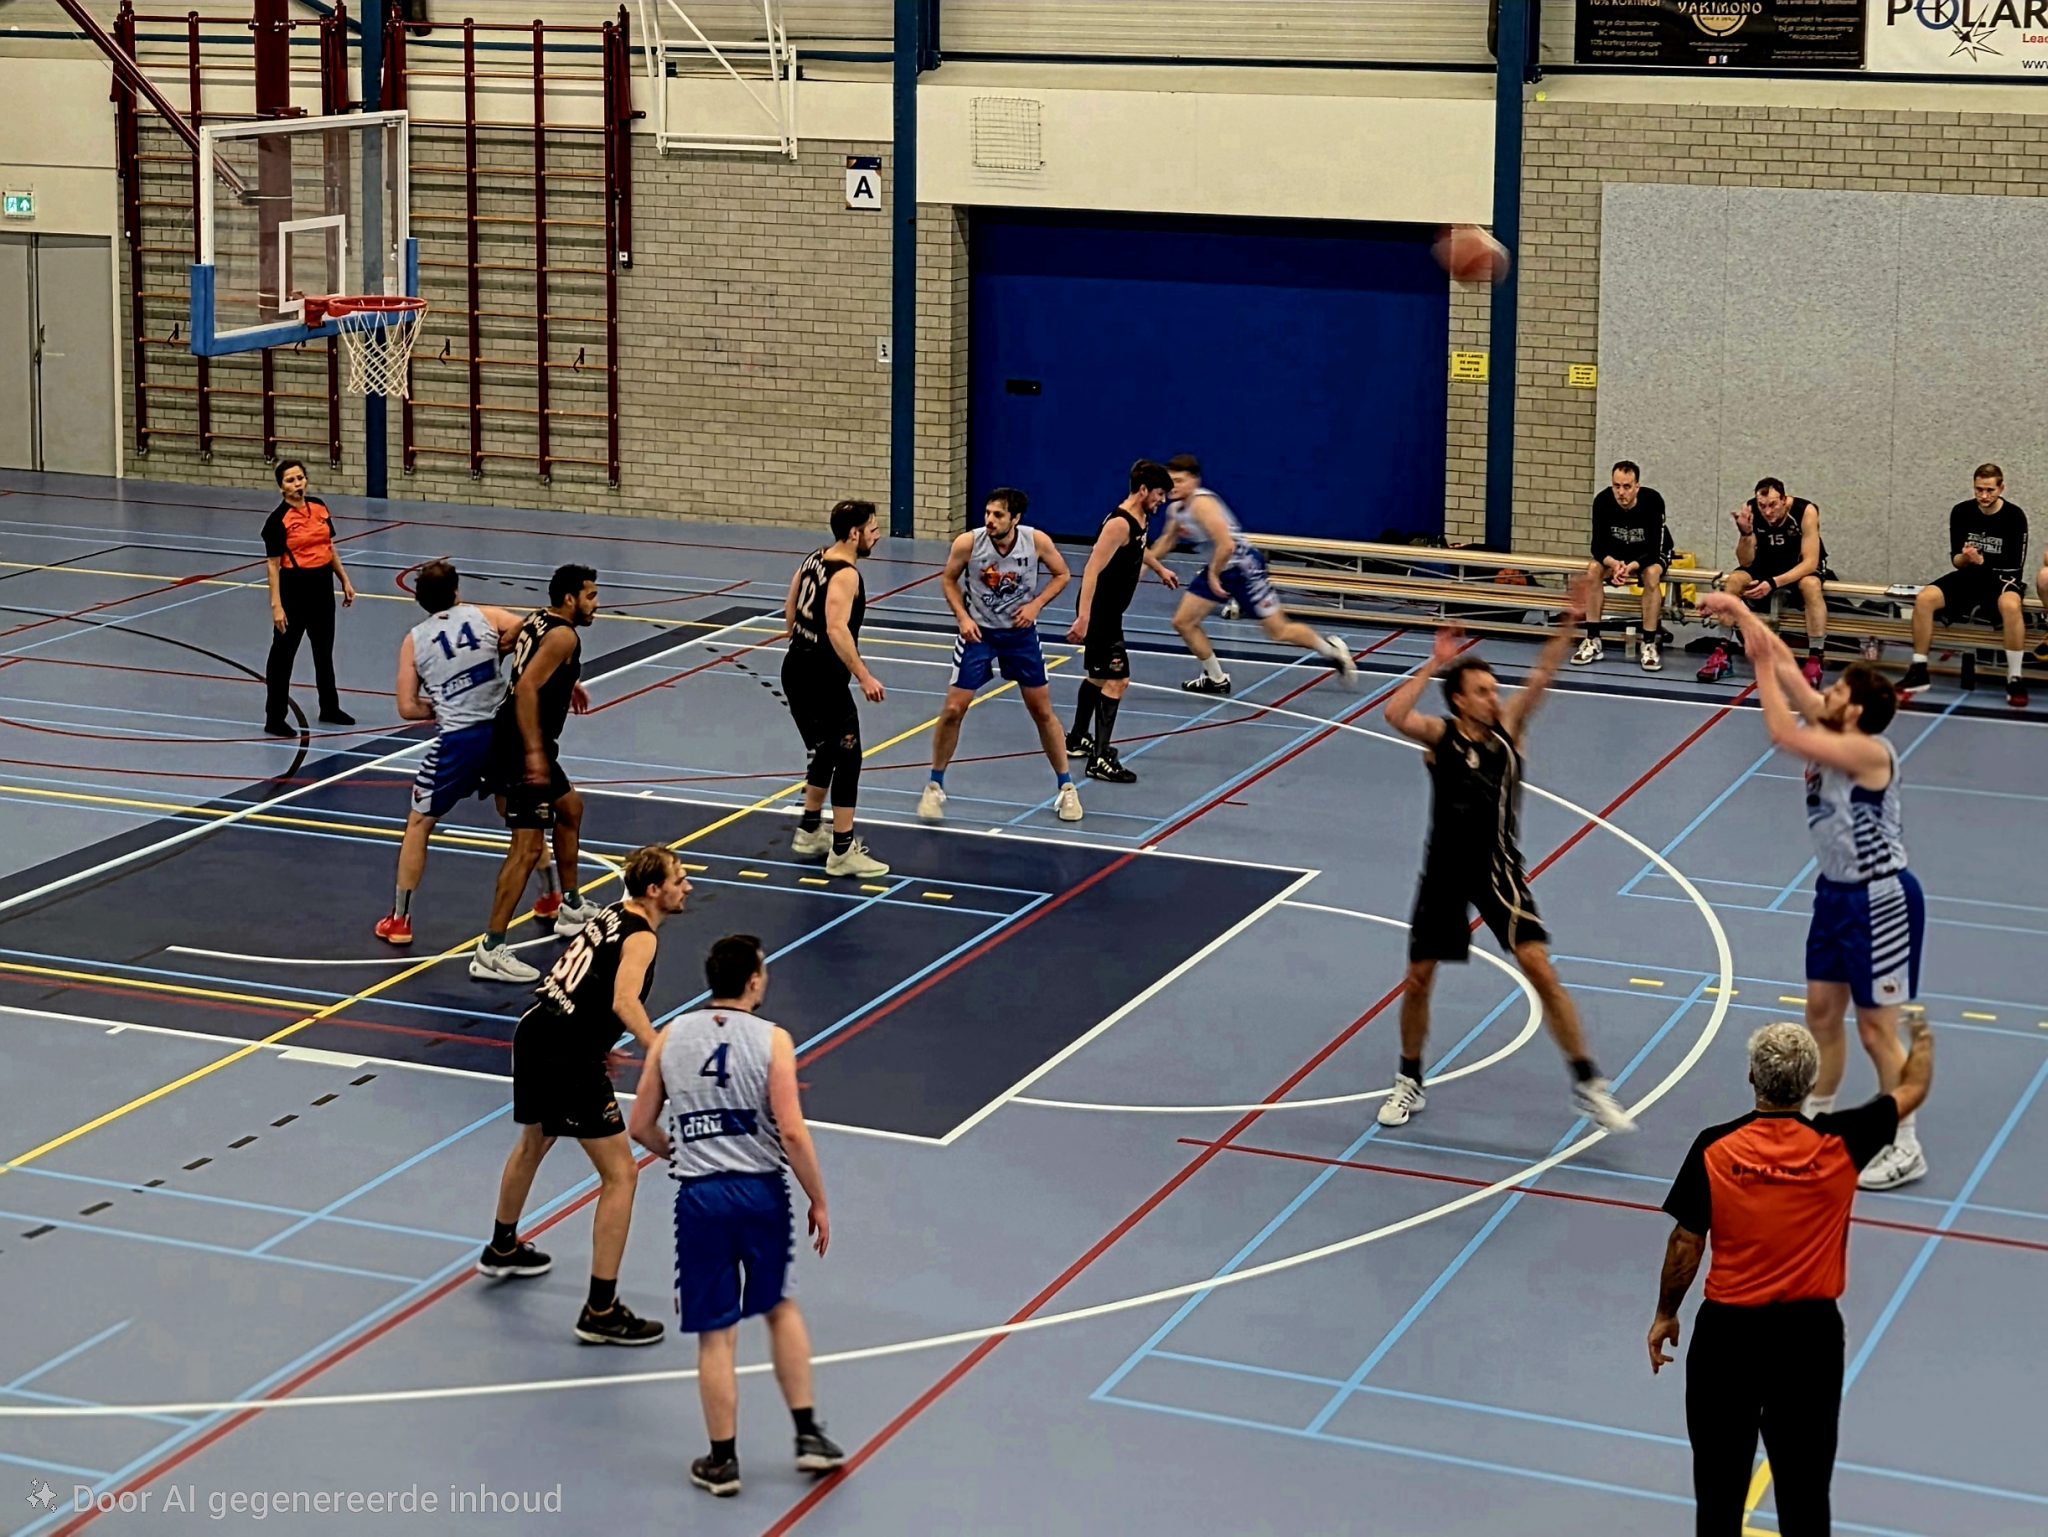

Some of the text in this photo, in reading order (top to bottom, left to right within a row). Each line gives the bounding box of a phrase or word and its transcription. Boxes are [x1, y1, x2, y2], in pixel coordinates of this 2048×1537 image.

[1677, 1, 1763, 14] YAKIMONO
[854, 175, 874, 199] A
[1767, 534, 1785, 546] 15
[1016, 557, 1029, 567] 11
[797, 575, 817, 620] 12
[431, 620, 482, 661] 14
[551, 934, 595, 994] 30
[700, 1042, 732, 1088] 4
